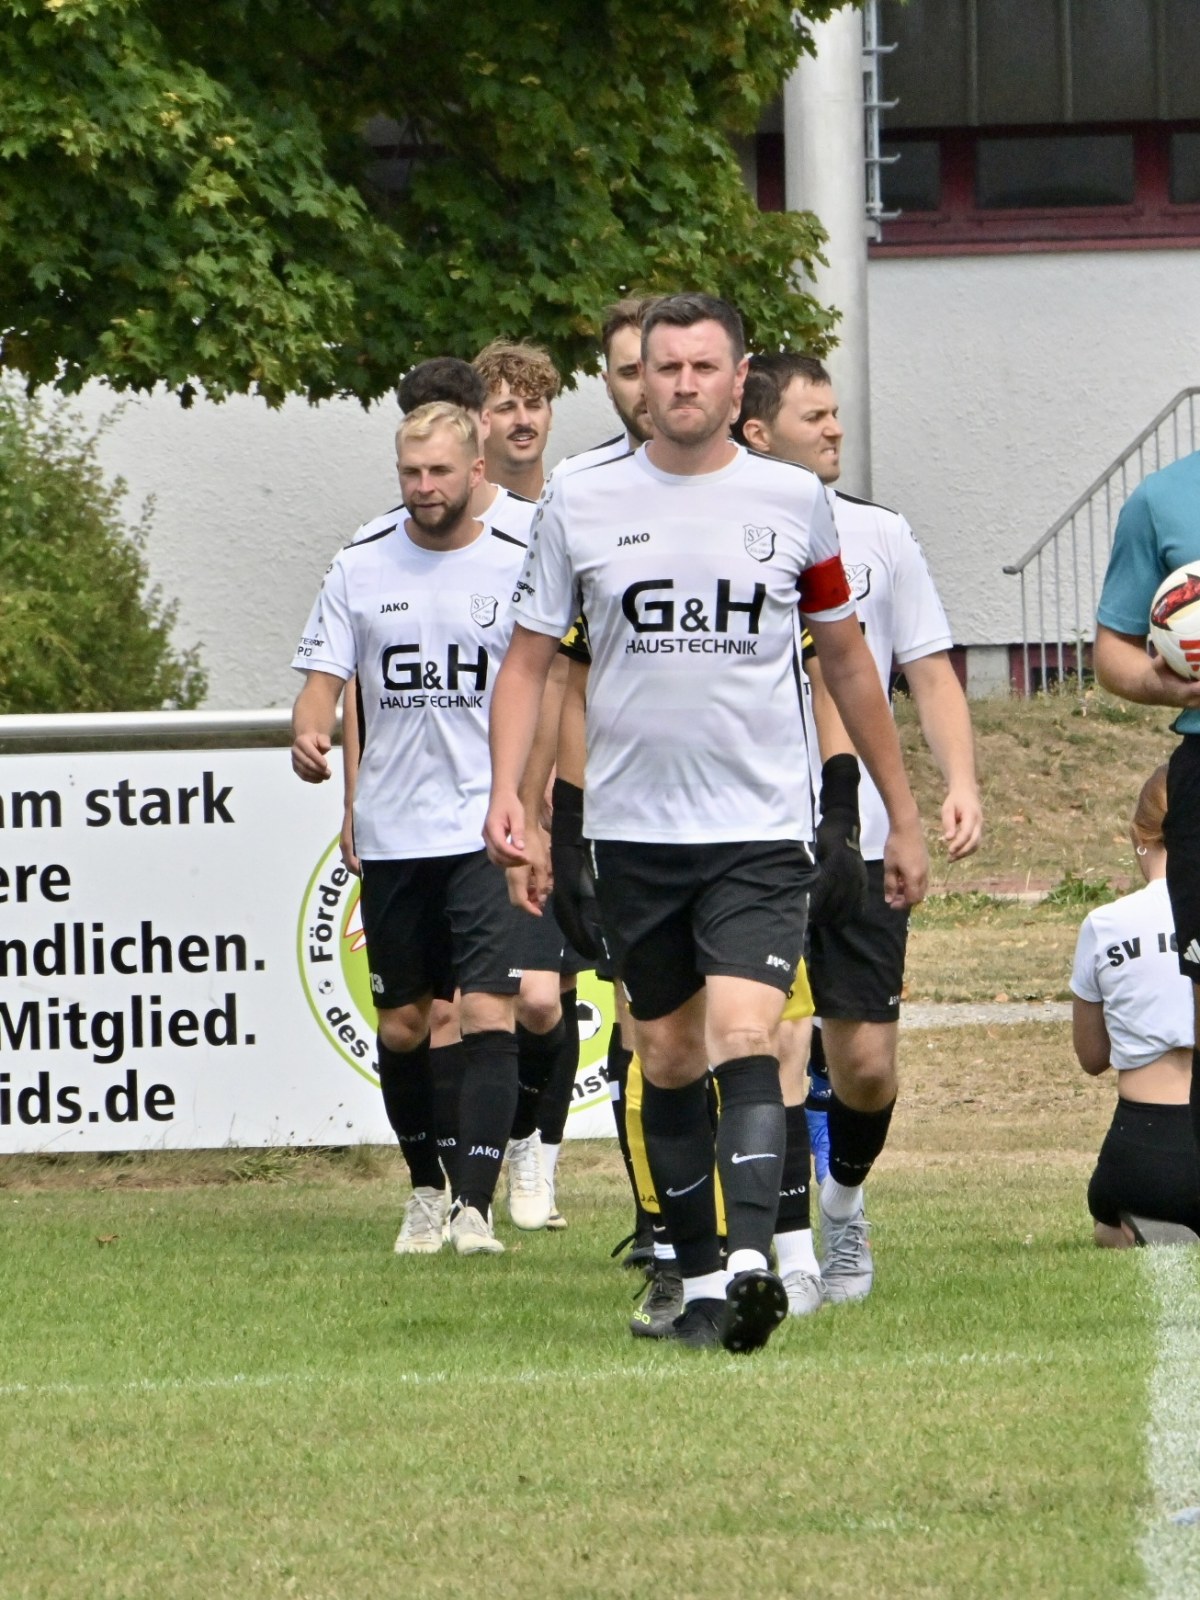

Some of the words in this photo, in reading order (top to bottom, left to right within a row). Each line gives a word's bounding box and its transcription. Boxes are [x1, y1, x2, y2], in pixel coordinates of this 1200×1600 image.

[617, 533, 650, 546] JAKO
[380, 602, 409, 613] JAKO
[622, 579, 766, 634] G&H
[382, 643, 488, 691] G&H
[626, 639, 757, 655] HAUSTECHNIK
[380, 695, 484, 709] HAUSTECHNIK
[0, 790, 62, 829] m
[86, 771, 234, 828] stark
[309, 858, 350, 963] Förde
[0, 921, 265, 977] ndlichen.
[1107, 937, 1141, 967] SV
[0, 992, 256, 1064] Mitglied.
[325, 1006, 370, 1058] des
[468, 1145, 500, 1159] JAKO
